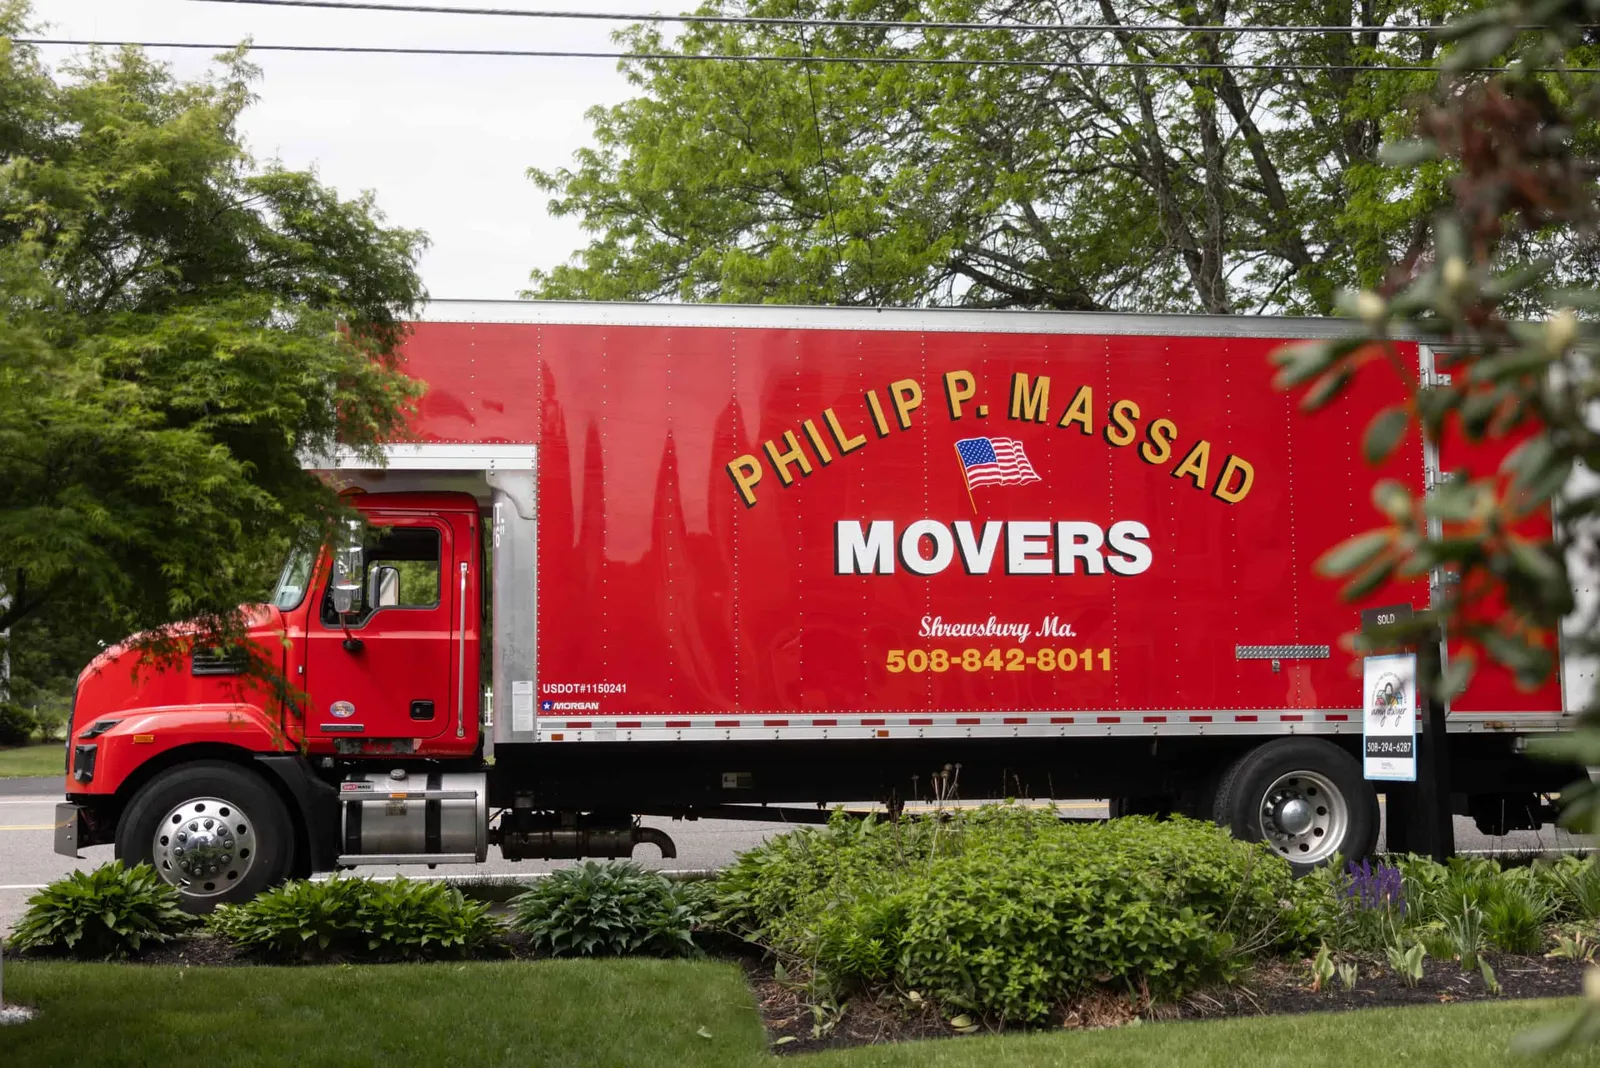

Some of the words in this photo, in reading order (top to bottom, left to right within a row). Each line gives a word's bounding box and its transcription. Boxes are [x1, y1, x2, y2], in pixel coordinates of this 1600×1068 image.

[726, 377, 923, 508] PHILIP
[943, 369, 988, 421] P.
[1008, 372, 1255, 505] MASSAD
[834, 519, 1153, 576] MOVERS
[1377, 613, 1395, 625] SOLD
[918, 615, 1032, 643] Shrewsbury
[1035, 616, 1077, 638] Ma.
[886, 648, 1112, 673] 508-842-8011
[542, 683, 627, 694] USDOT#1150241
[552, 702, 599, 710] MORGAN
[1367, 741, 1412, 753] 508-294-6287
